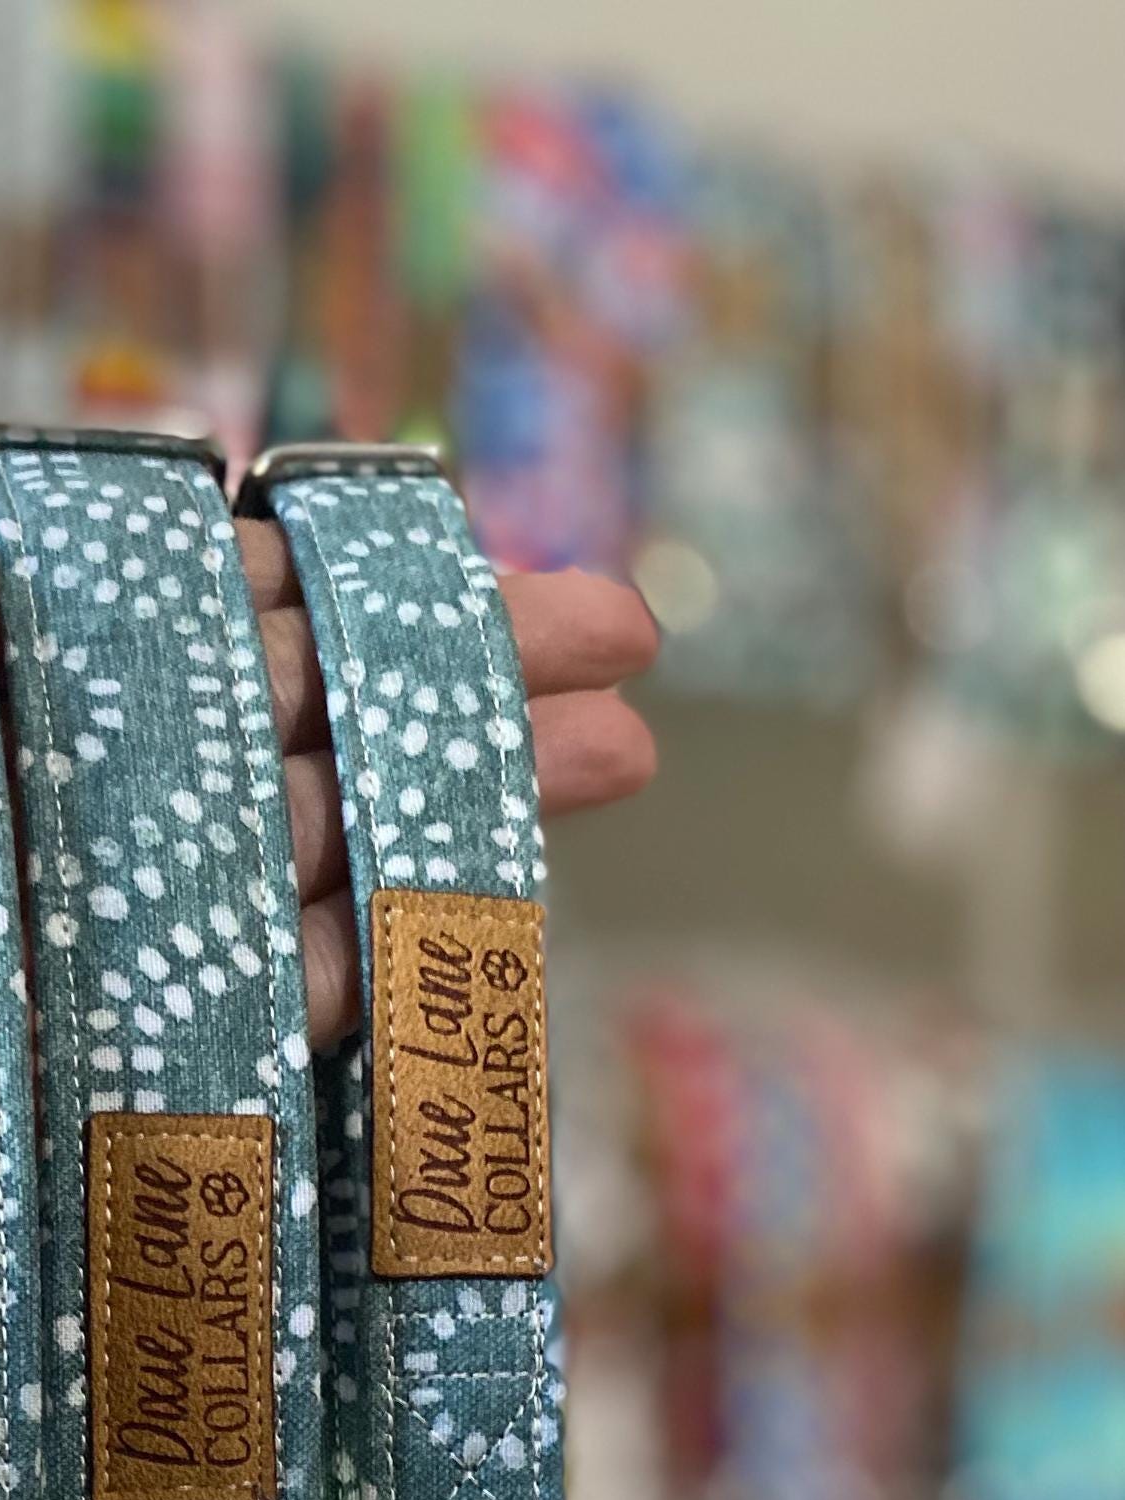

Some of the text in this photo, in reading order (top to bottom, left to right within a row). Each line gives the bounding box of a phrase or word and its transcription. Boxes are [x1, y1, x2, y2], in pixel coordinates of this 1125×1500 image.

[399, 930, 478, 1067] Lane
[483, 1012, 531, 1235] COLLARS
[114, 1156, 195, 1300] Lane
[200, 1240, 251, 1468] COLLARS
